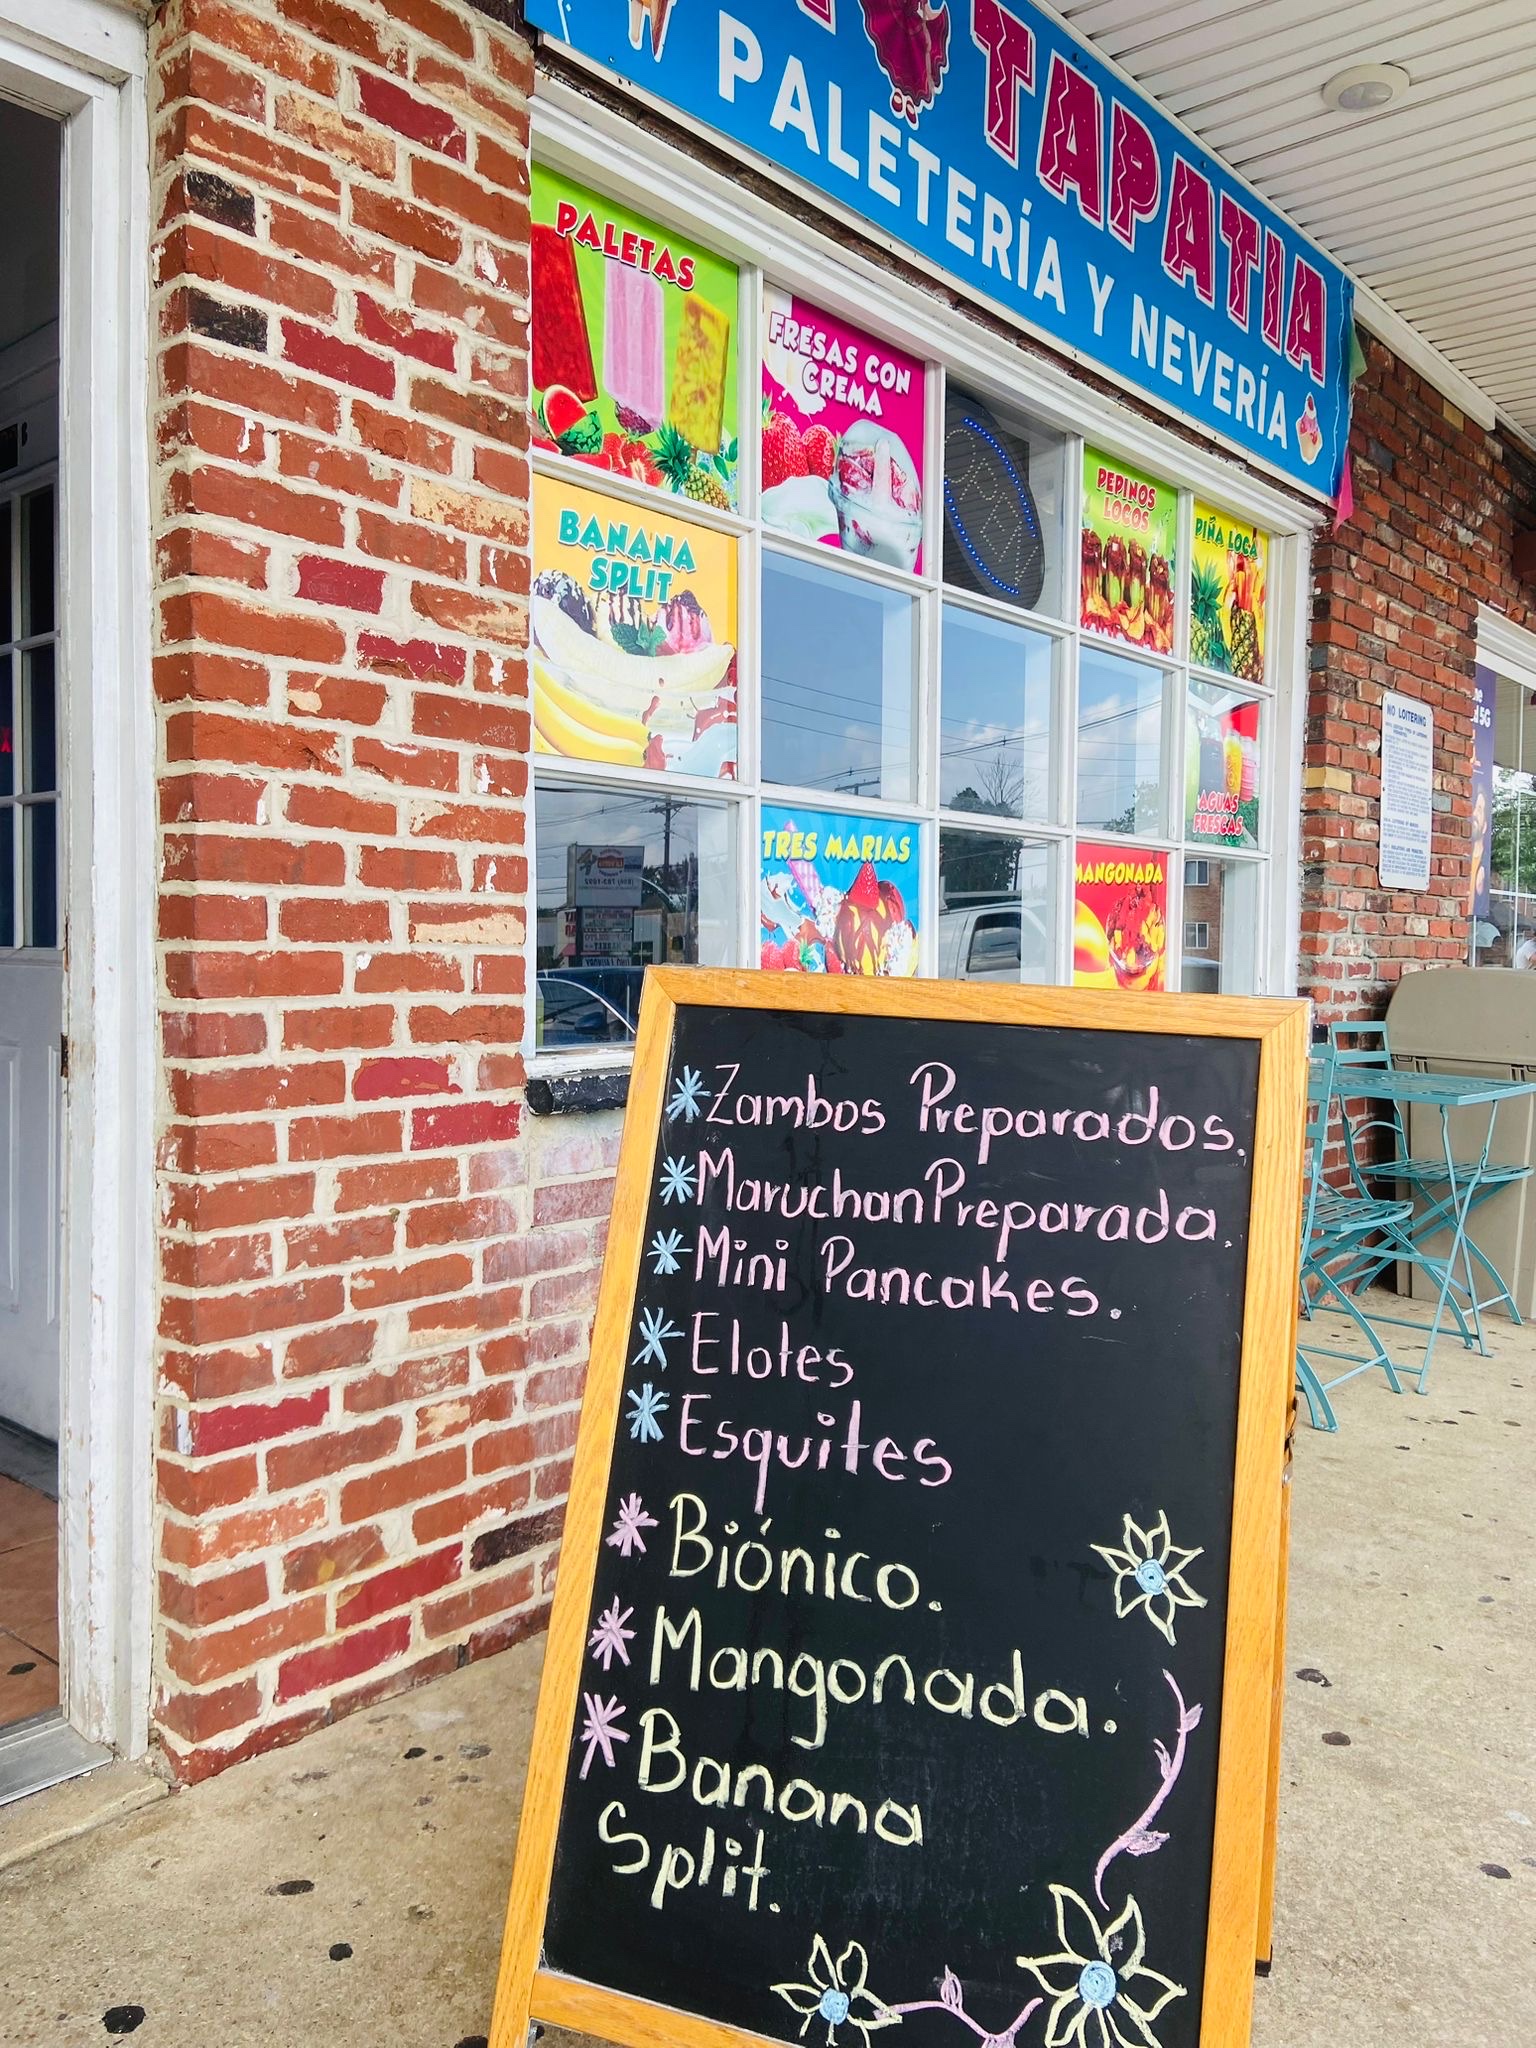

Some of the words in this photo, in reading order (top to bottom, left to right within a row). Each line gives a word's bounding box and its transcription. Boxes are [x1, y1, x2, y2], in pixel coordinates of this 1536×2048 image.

[972, 0, 1327, 388] TAPATIA
[555, 202, 696, 291] PALETAS
[718, 10, 1066, 315] PALETERÍA
[1085, 274, 1116, 336] Y
[1131, 293, 1287, 449] NEVERÍA
[770, 311, 858, 374] FRESAS
[865, 355, 912, 395] CON
[802, 362, 884, 418] CREMA
[1097, 468, 1156, 510] PEPINOS
[1104, 497, 1149, 533] LOCOS
[558, 510, 697, 574] BANANA
[1195, 516, 1223, 546] PIÑA
[1228, 530, 1258, 559] LOCA
[590, 556, 672, 604] SPLIT
[1386, 703, 1396, 717] NO
[1398, 706, 1427, 728] LOITERING
[1479, 706, 1491, 728] 5G
[1193, 814, 1244, 837] FRESCAS
[1198, 789, 1239, 815] AGUAS
[762, 830, 818, 861] TRES
[824, 834, 911, 863] MARIAS
[1076, 861, 1163, 885] MANGONADA
[705, 1063, 886, 1134] Zambos
[910, 1061, 1247, 1165] Preparados.
[696, 1225, 789, 1292] Mini
[821, 1235, 1123, 1320] Pancakes.
[691, 1312, 855, 1388] Elotes
[679, 1393, 953, 1514] Esquites
[669, 1492, 943, 1612] Biónico.
[649, 1605, 1118, 1750] Mangonada.
[638, 1707, 925, 1847] Banana
[598, 1800, 783, 1913] Split.
